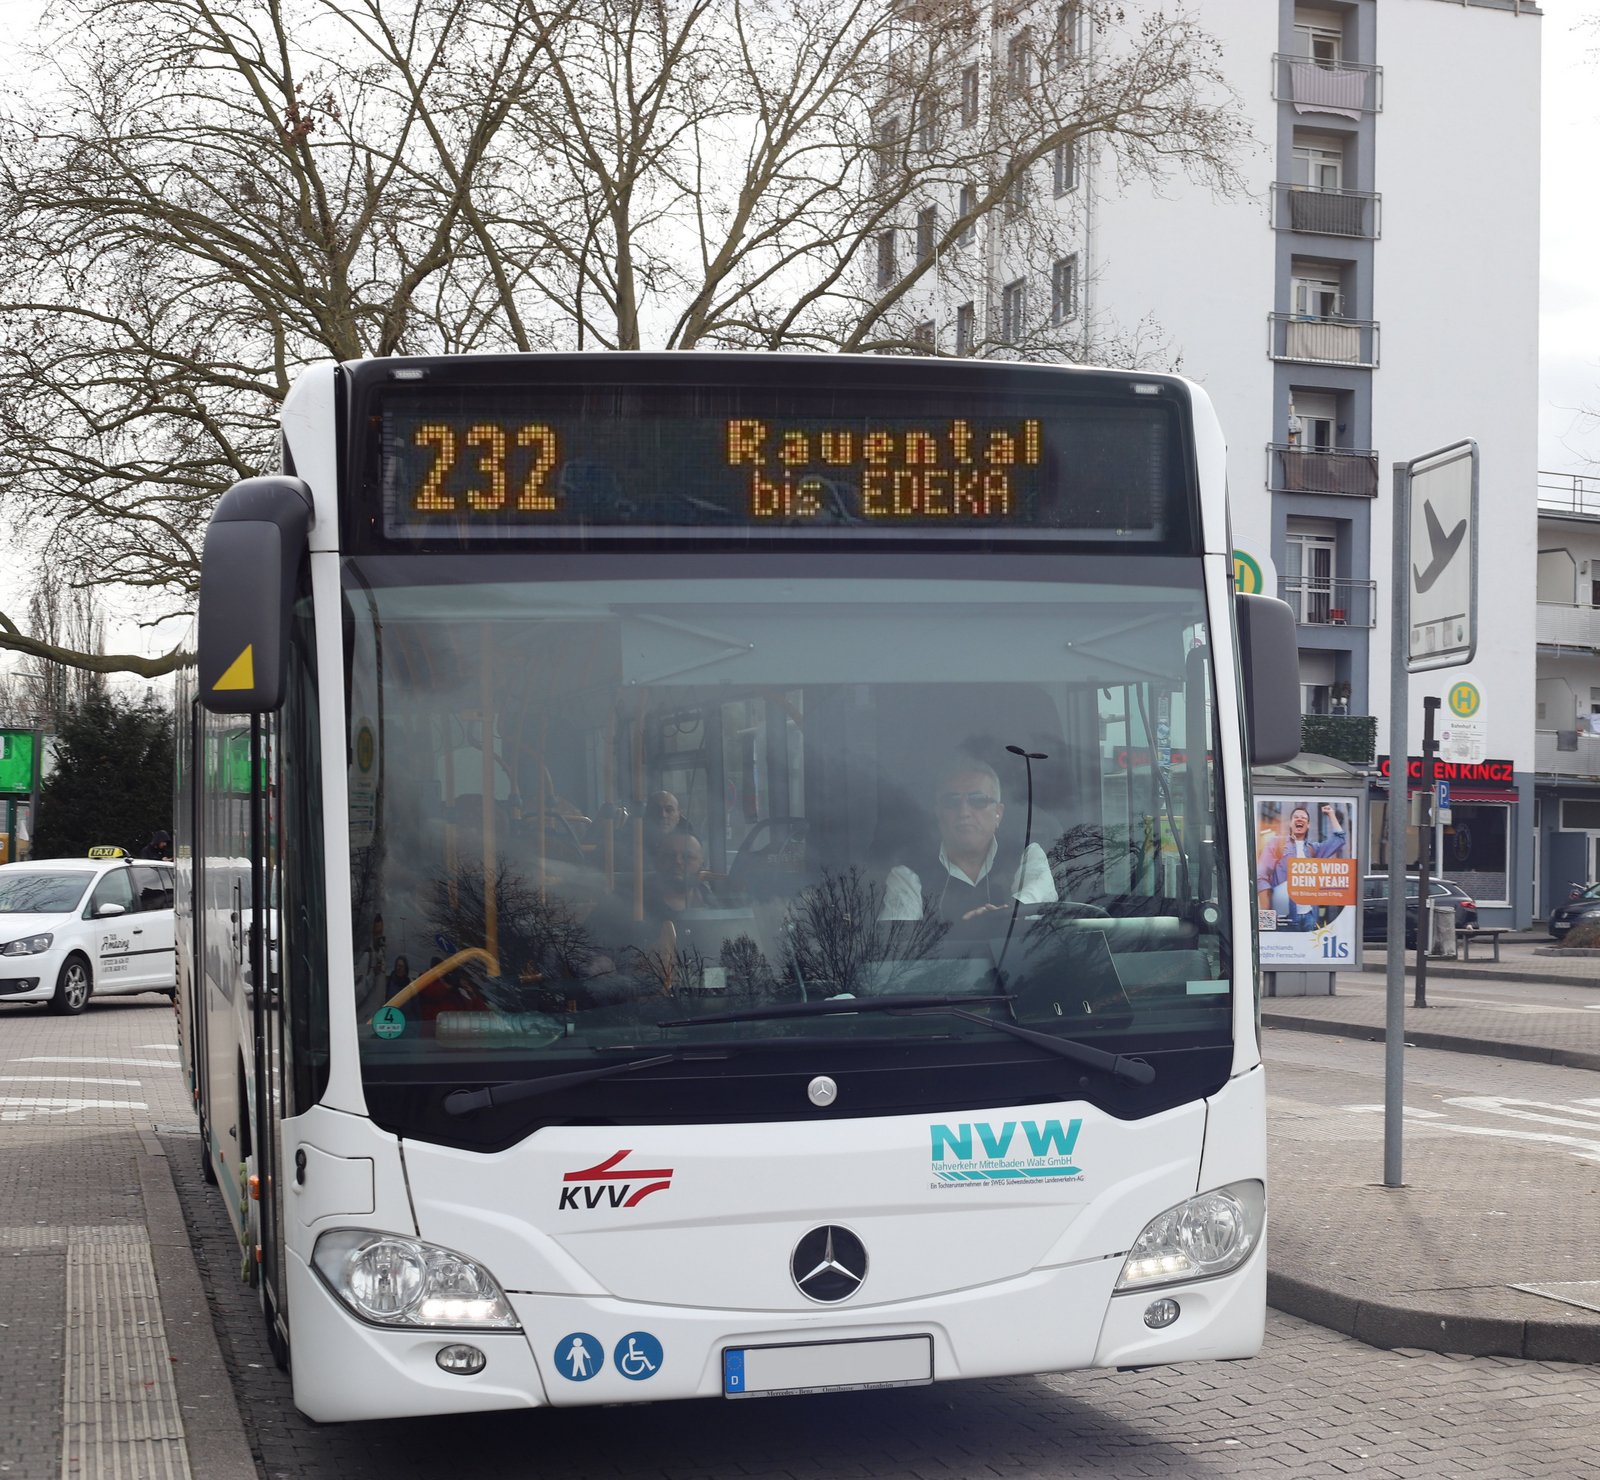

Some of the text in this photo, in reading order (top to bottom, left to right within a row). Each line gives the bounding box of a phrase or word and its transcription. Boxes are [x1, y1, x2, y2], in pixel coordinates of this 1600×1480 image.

[727, 419, 1040, 464] Rauental
[415, 425, 556, 510] 232
[754, 469, 1007, 515] bis EDEKA
[1457, 690, 1471, 710] H
[1381, 760, 1513, 781] CICEN KINGZ
[1441, 785, 1447, 805] P
[93, 848, 113, 856] TAXI
[1291, 862, 1349, 874] 2026 WIRD
[1291, 876, 1349, 887] DEIN YEAH!
[1322, 935, 1349, 958] ils
[384, 1007, 394, 1023] 4
[930, 1119, 1083, 1161] NVW
[931, 1157, 1072, 1171] Nahverkehr Mittelbaden Walz GmbH
[938, 1181, 982, 1189] Tochterunternehmen
[1044, 1176, 1084, 1184] Landesverkehrs-AG
[558, 1184, 631, 1210] KVV
[731, 1376, 739, 1386] D
